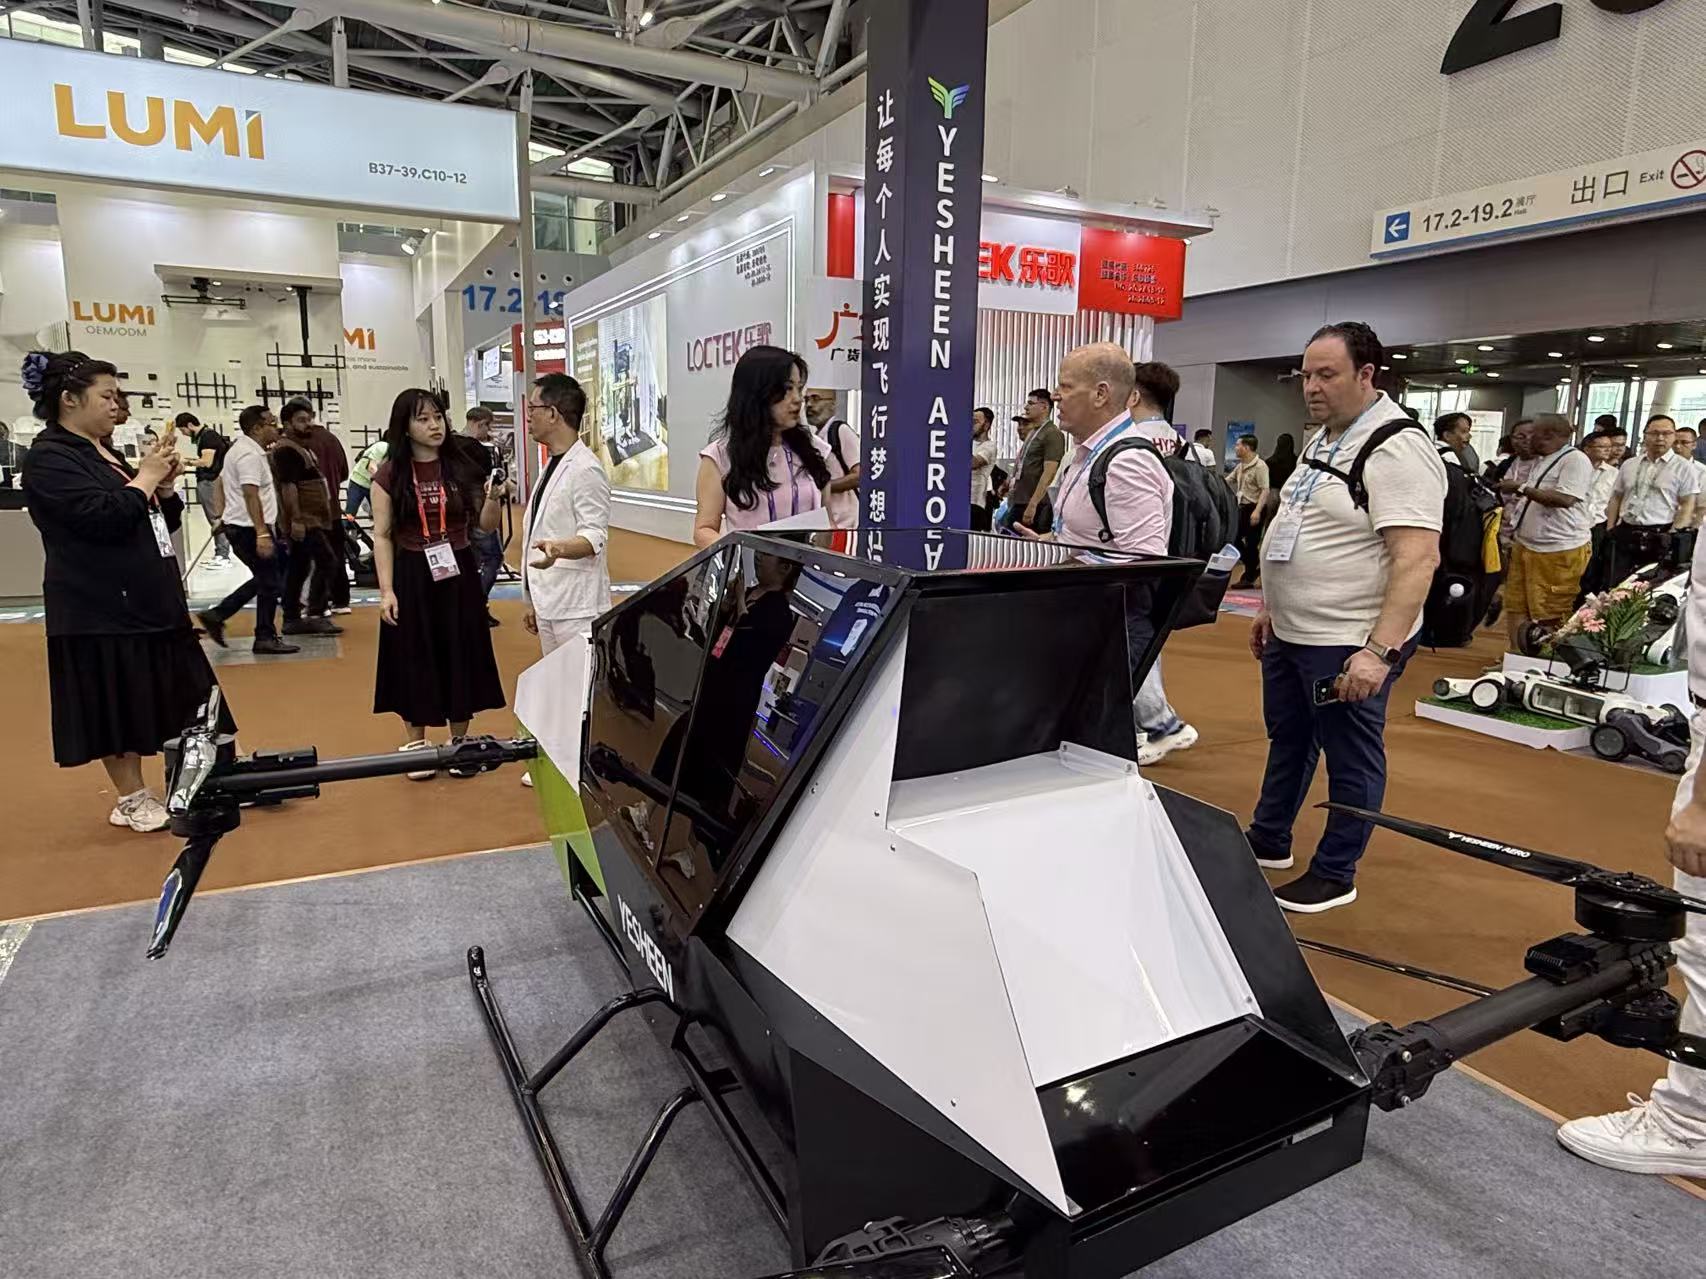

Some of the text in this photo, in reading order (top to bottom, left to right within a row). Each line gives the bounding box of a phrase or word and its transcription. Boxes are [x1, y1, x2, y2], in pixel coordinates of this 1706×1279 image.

[1570, 170, 1664, 204] 出口 Exit
[1423, 198, 1514, 233] 17.2-19.2
[930, 124, 957, 369] YESHEEN
[1019, 247, 1076, 288] 乐歌
[869, 88, 894, 523] 让每个人实现飞行梦想
[85, 325, 147, 337] OEM/ODM
[686, 328, 743, 372] LOCTEK
[830, 348, 861, 362] 广货
[925, 396, 949, 524] AERO
[617, 893, 675, 1003] YESHEEN
